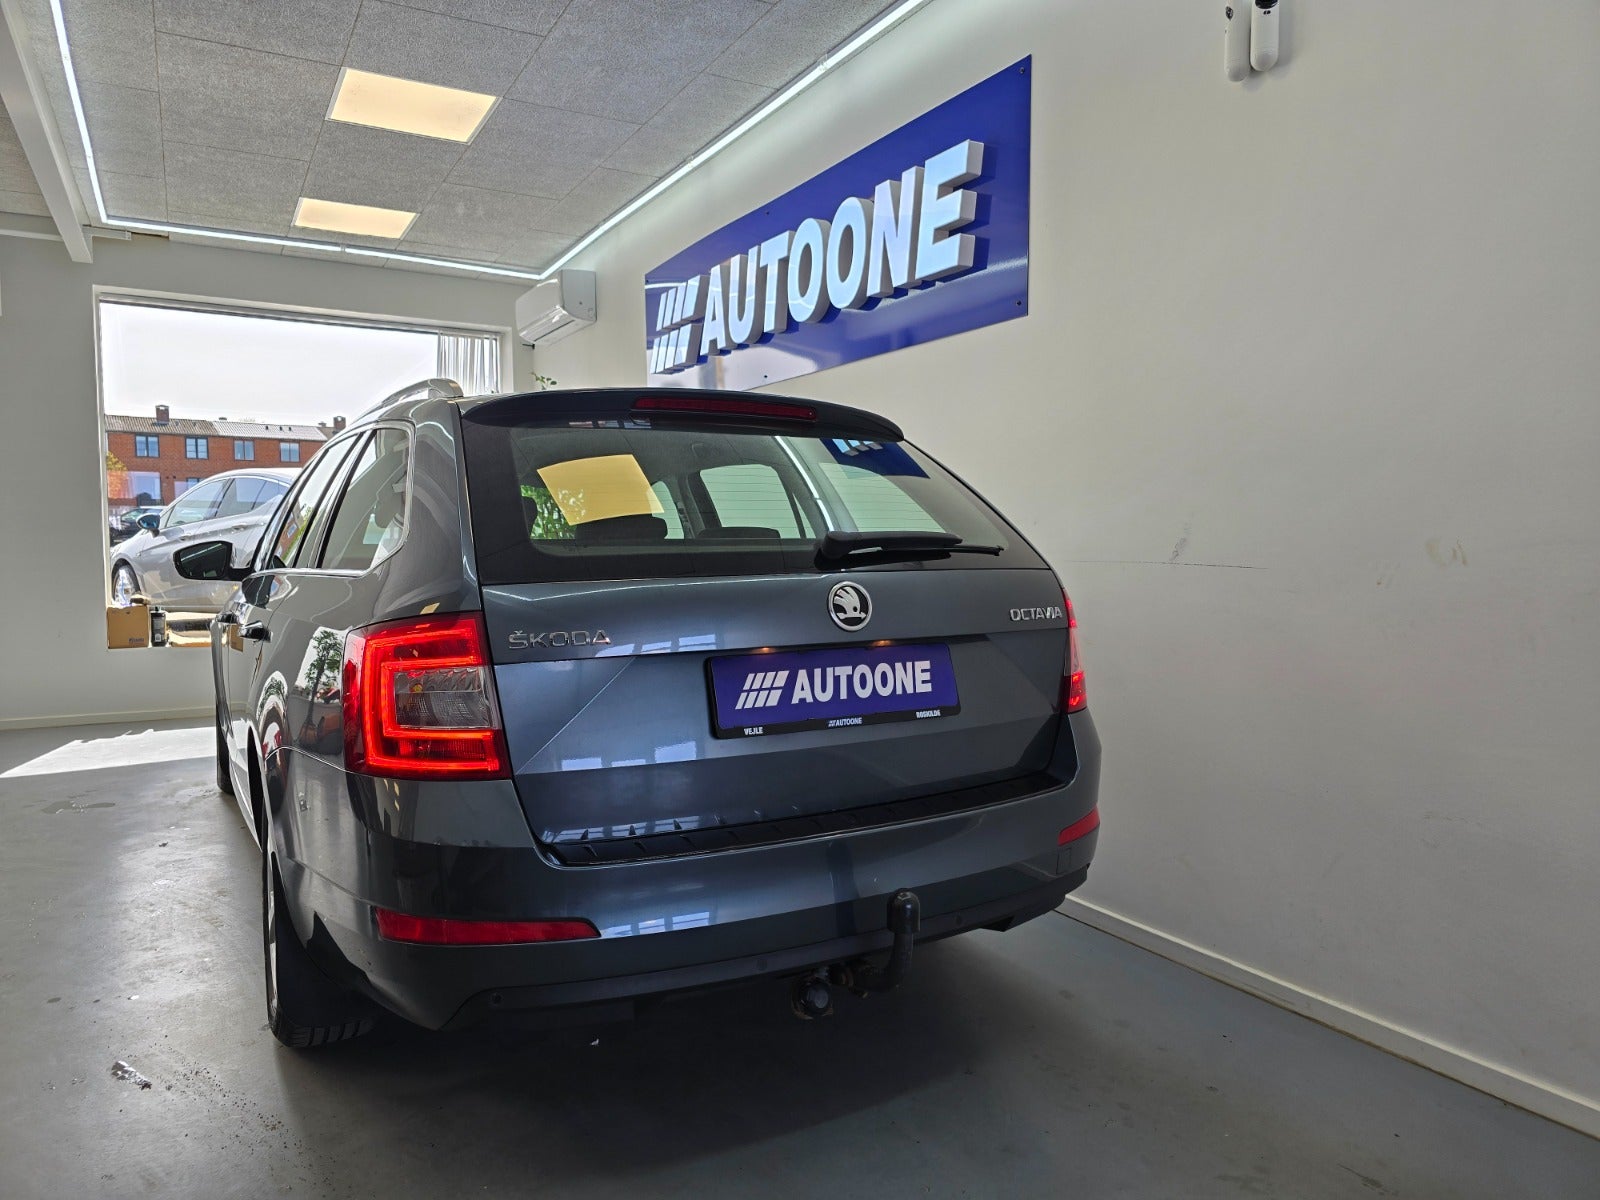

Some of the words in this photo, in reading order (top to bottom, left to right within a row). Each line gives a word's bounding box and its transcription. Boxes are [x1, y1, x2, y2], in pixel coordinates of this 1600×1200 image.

[699, 138, 985, 359] AUTOONE
[1009, 606, 1063, 621] OCTAVIA
[508, 629, 612, 649] ŠKODA
[791, 660, 932, 705] AUTOONE
[835, 717, 863, 727] AUTOONE
[743, 726, 764, 736] VEJLE
